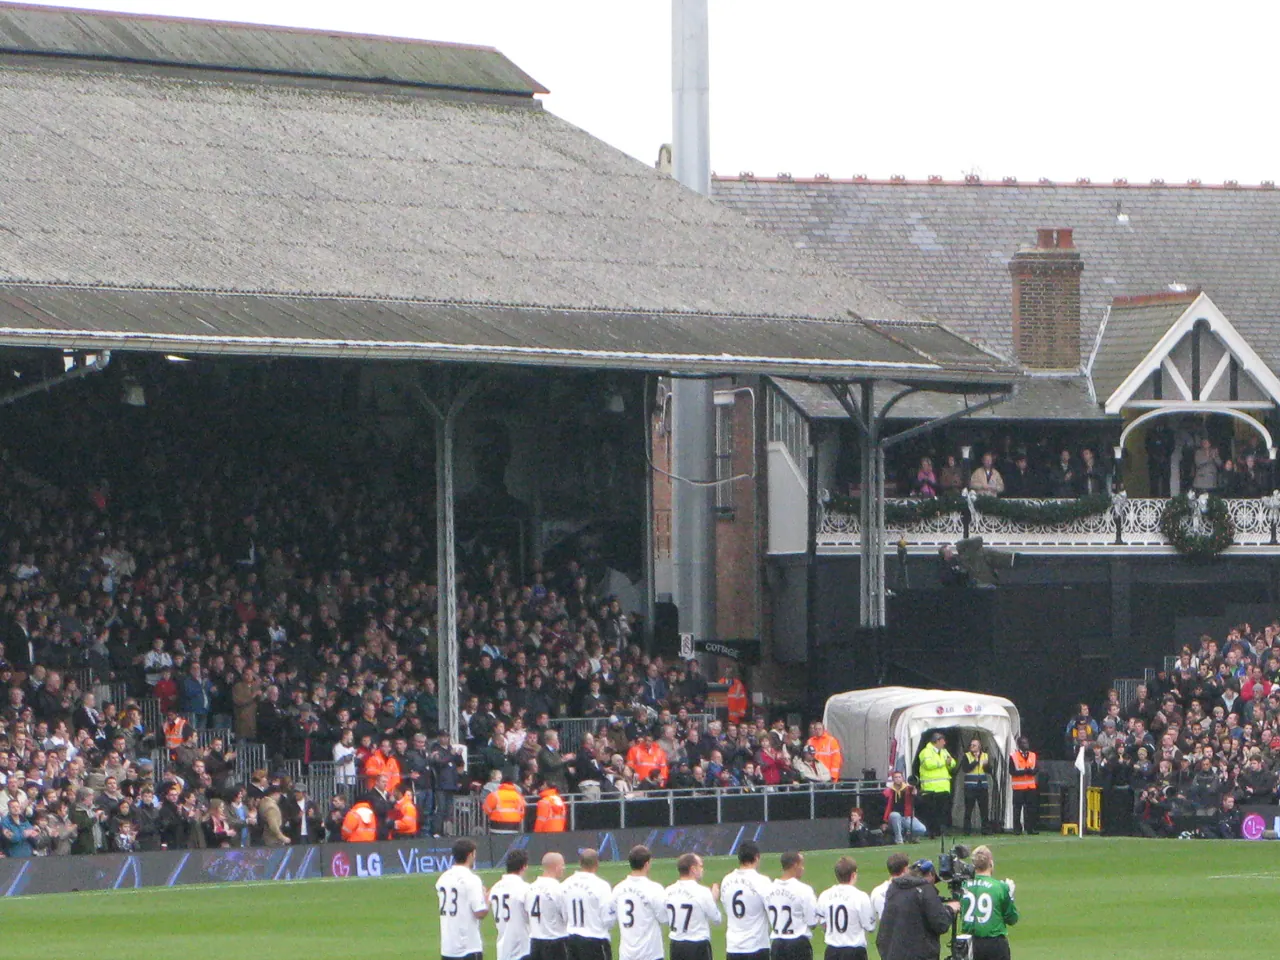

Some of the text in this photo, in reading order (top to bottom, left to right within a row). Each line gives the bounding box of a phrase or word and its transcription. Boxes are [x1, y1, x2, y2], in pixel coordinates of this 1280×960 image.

[705, 643, 740, 658] COTTAGE
[356, 852, 383, 877] LG
[440, 886, 458, 916] 23
[491, 893, 511, 923] 25
[530, 894, 541, 924] 4
[572, 898, 585, 928] 11
[622, 899, 635, 928] 3
[732, 889, 746, 919] 6
[962, 890, 993, 924] 29
[666, 903, 693, 933] 27
[768, 905, 794, 935] 22
[829, 904, 849, 934] 10
